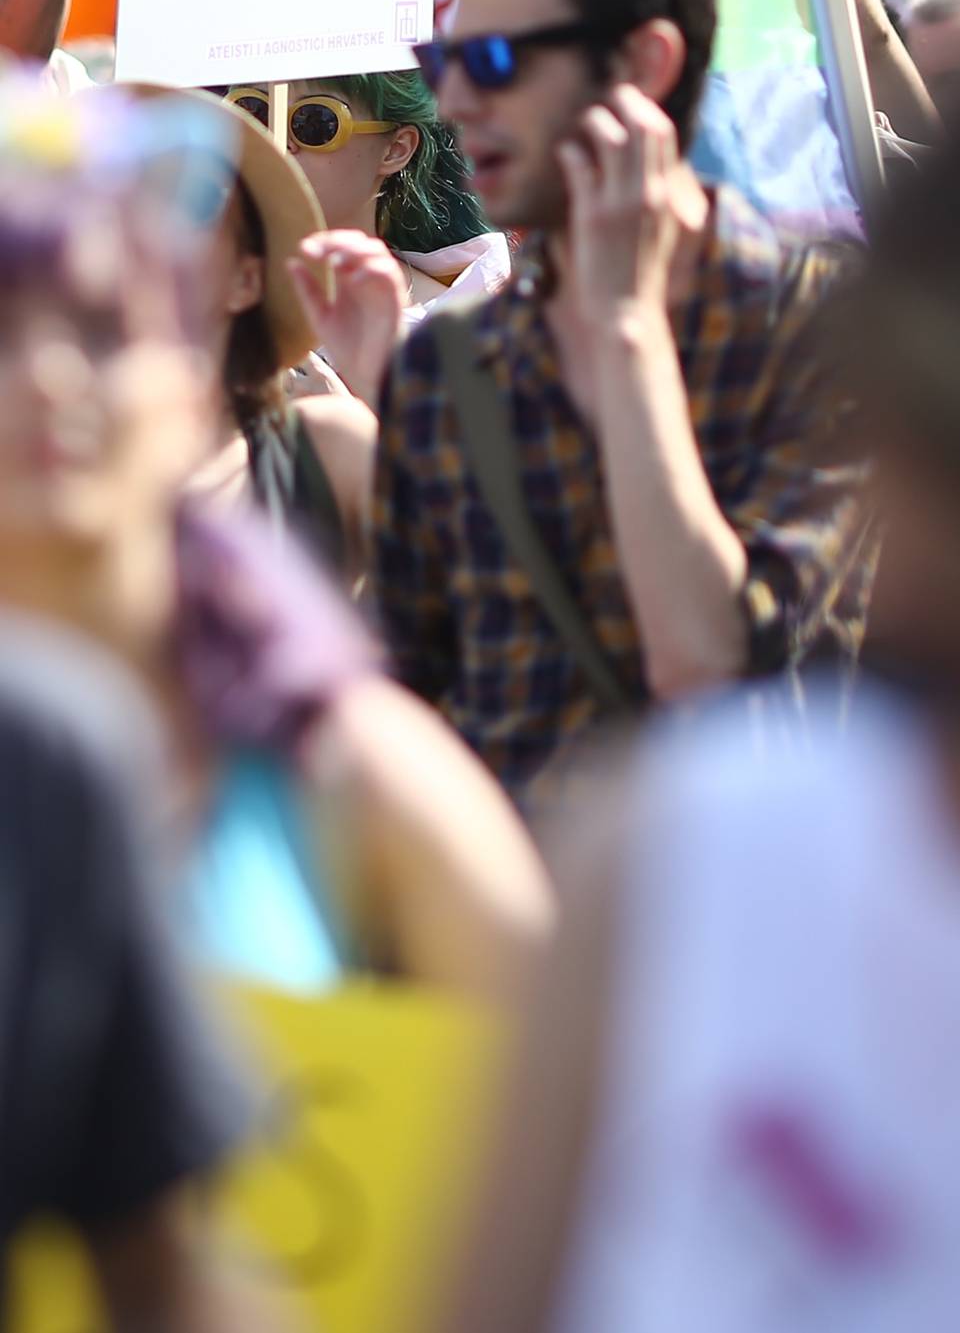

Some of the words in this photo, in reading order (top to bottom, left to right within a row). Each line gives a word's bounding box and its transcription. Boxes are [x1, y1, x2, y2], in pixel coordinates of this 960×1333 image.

[207, 43, 253, 60] ATEISTI
[264, 37, 325, 56] AGNOSTICI
[327, 31, 385, 49] HRVATSKE
